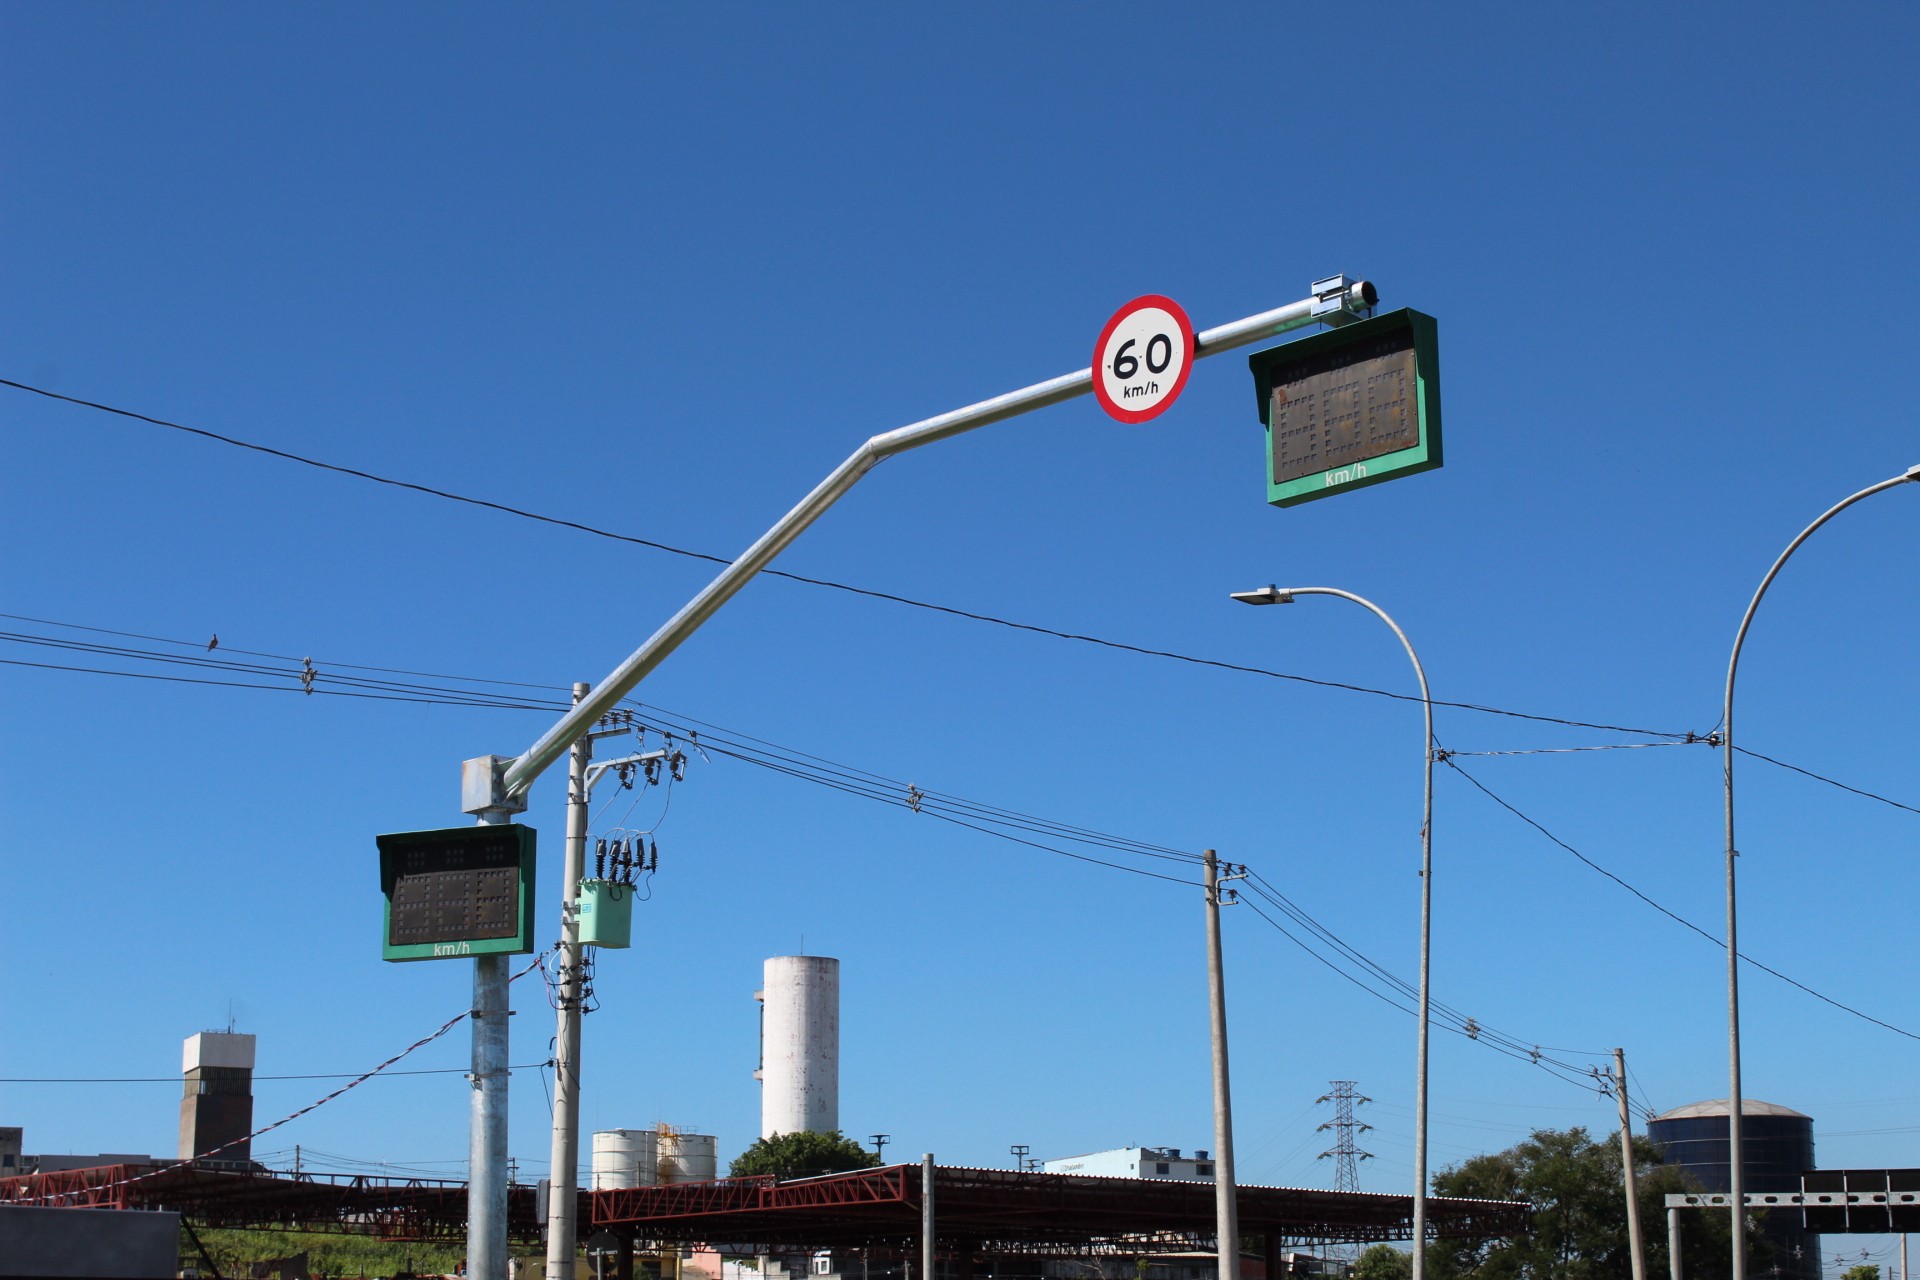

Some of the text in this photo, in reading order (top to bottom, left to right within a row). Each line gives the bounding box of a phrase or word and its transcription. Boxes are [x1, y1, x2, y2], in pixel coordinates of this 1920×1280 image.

[1113, 333, 1172, 380] 60
[1123, 381, 1158, 398] km/h
[1325, 464, 1366, 487] km/h
[433, 941, 470, 957] km/h
